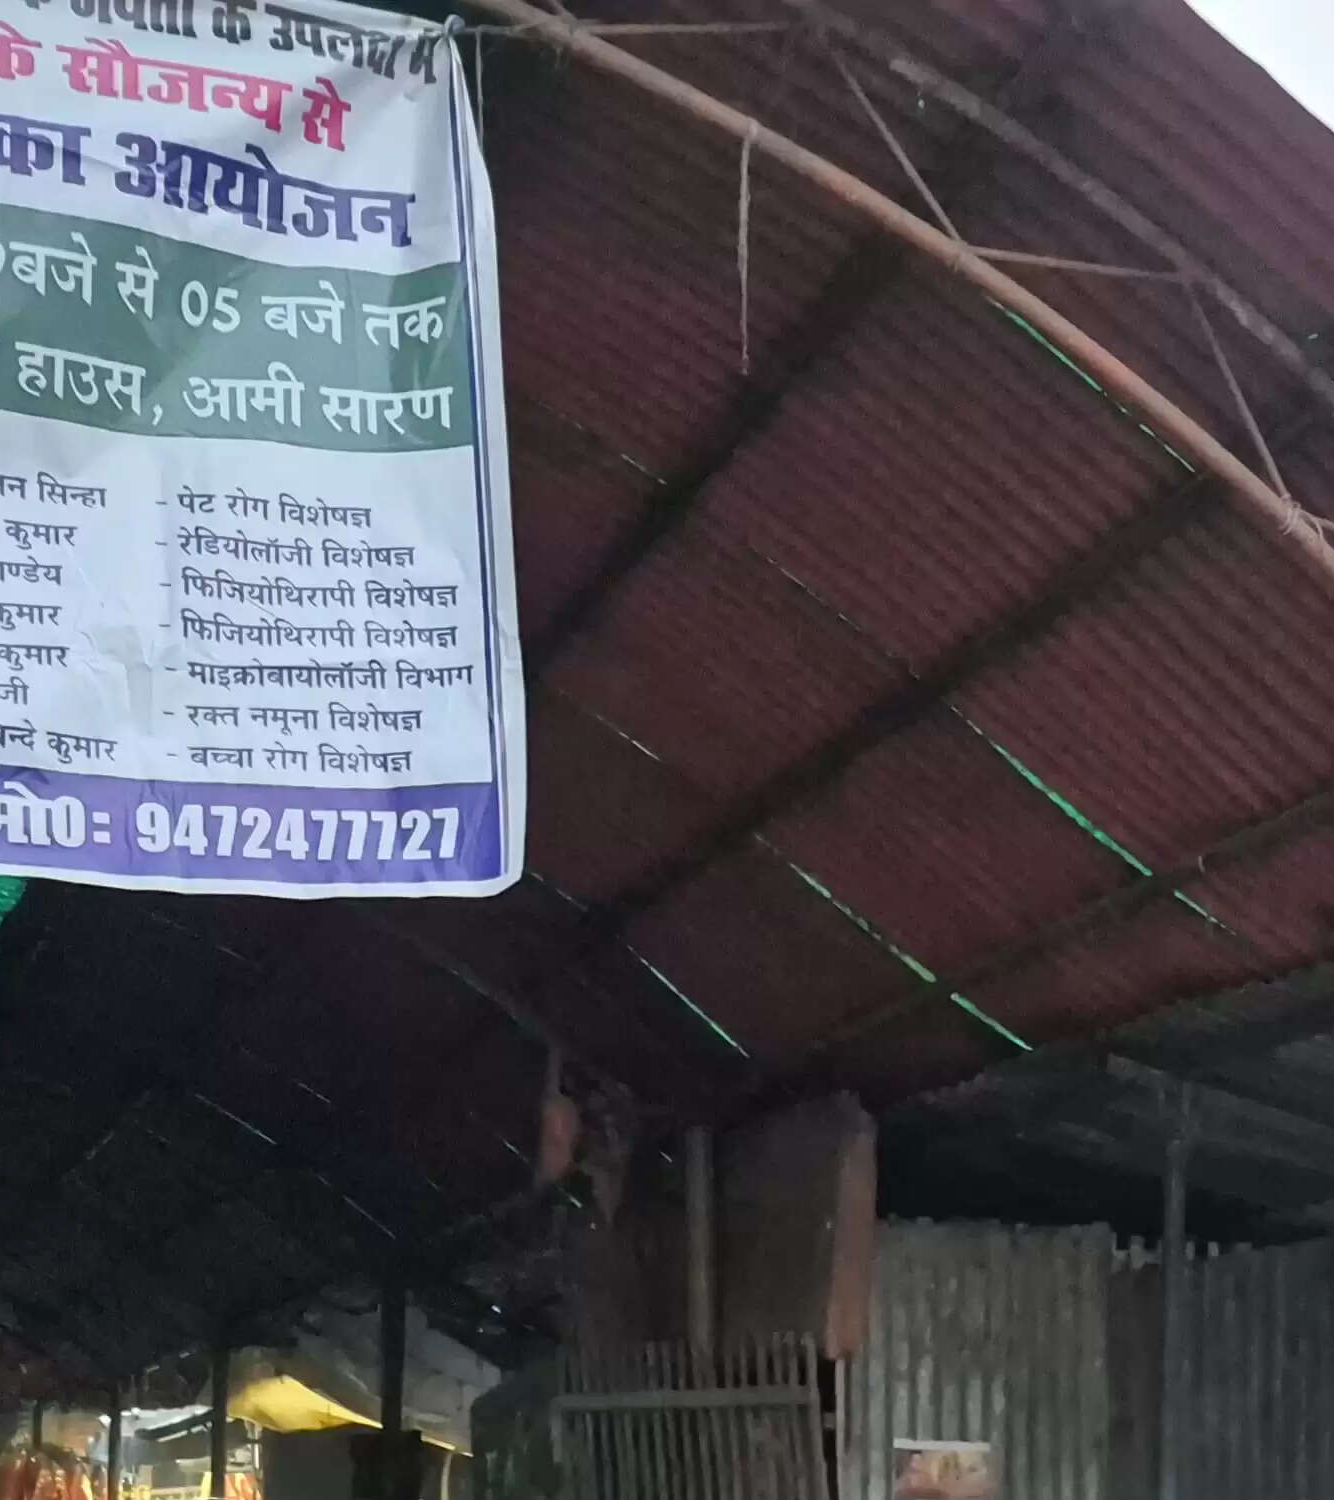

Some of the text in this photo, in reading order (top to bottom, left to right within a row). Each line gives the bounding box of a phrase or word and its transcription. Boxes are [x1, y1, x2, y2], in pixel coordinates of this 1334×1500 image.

[56, 37, 292, 133] सौजन्य
[302, 76, 351, 151] से
[115, 132, 415, 247] आयोजन
[115, 246, 159, 320] से
[181, 280, 240, 334] 05
[262, 281, 345, 344] बजे
[362, 297, 446, 349] तक
[183, 361, 305, 428] आमी
[319, 386, 453, 435] सारण
[37, 471, 107, 508] सिन्हा
[177, 485, 371, 528] पेट रोग विशेषज्ञ
[4, 518, 78, 550] कुमार
[321, 538, 414, 568] विशेषज्ञ
[365, 578, 458, 609] विशेषज्ञ
[364, 619, 458, 648] विशेषज्ञ
[395, 659, 473, 689] विभाग
[185, 702, 422, 735] रक्त नमूना विशेषज्ञ
[46, 731, 118, 764] कुमार
[187, 741, 411, 773] बच्चा रोग विशेषज्ञ
[135, 803, 460, 863] 9472477727
